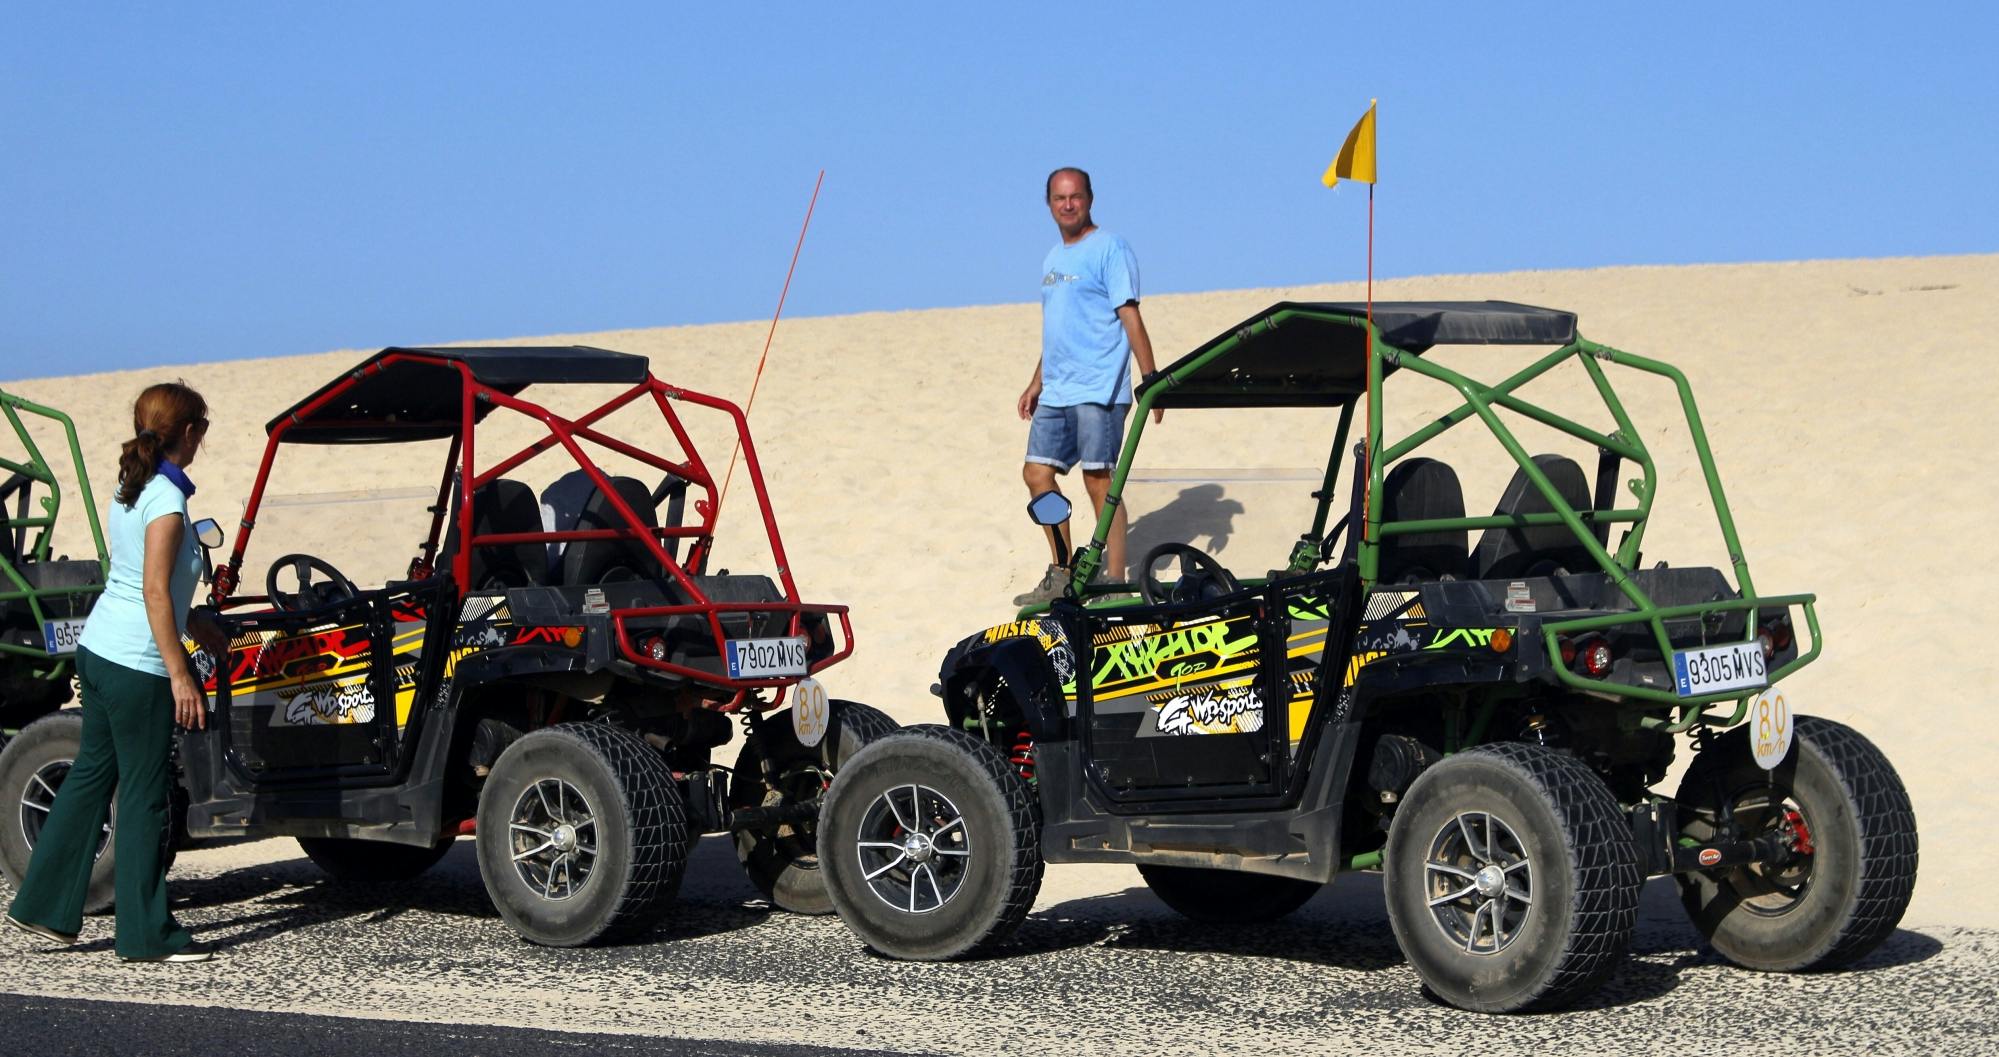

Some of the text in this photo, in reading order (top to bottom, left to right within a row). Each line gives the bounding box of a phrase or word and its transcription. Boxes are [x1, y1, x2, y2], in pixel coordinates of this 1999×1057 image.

[731, 663, 737, 671] E
[1680, 678, 1687, 688] E
[799, 685, 823, 721] 80
[1759, 695, 1786, 740] 80
[799, 720, 824, 736] km/h
[1757, 735, 1786, 758] km/h
